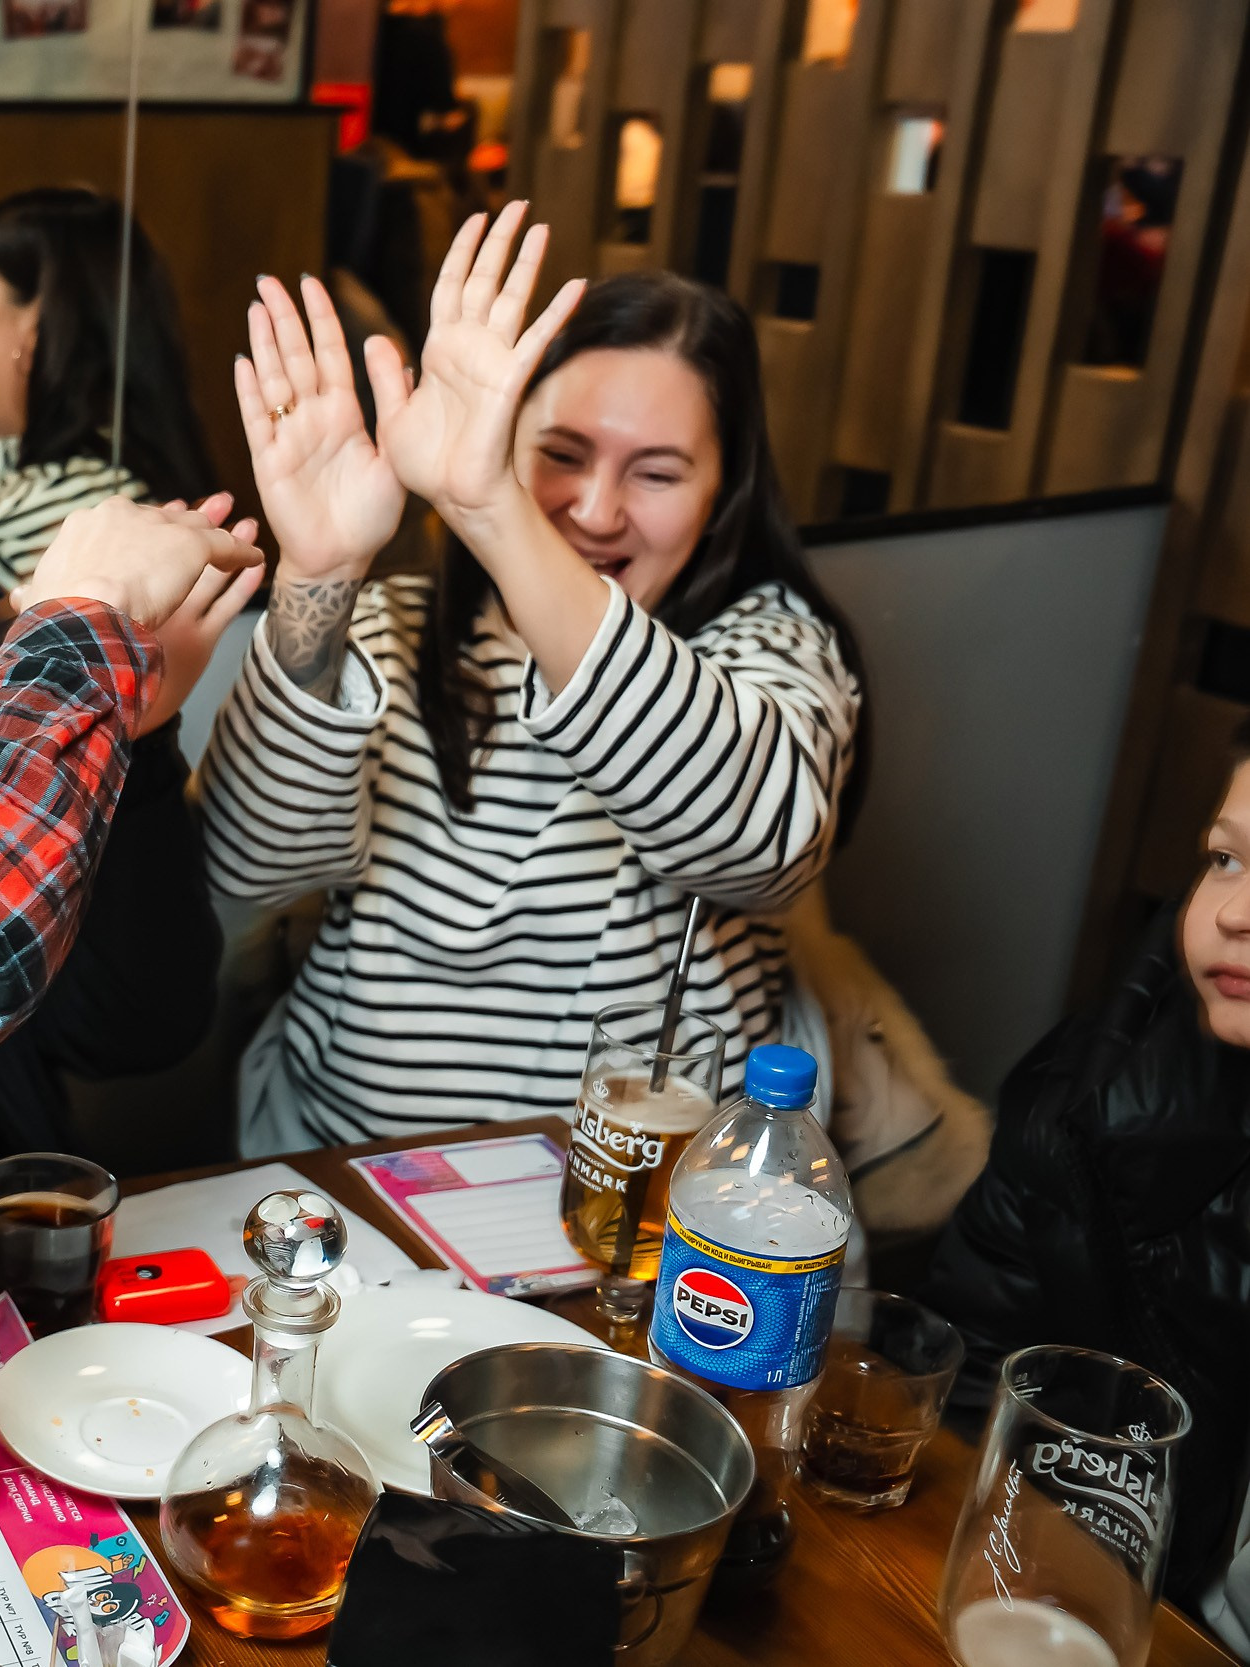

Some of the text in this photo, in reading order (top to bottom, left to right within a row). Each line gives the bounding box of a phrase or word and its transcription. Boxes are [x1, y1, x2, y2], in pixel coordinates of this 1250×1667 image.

[710, 1246, 723, 1259] КОД
[723, 1251, 729, 1261] И
[676, 1285, 748, 1328] PEPSI
[767, 1369, 783, 1383] 1 Л
[2, 1477, 33, 1523] ДЛЯ СВЕРКИ
[18, 1474, 41, 1506] КОМАНД
[40, 1483, 67, 1523] ЖЕЛАНИЮ
[14, 1624, 27, 1640] ТУР
